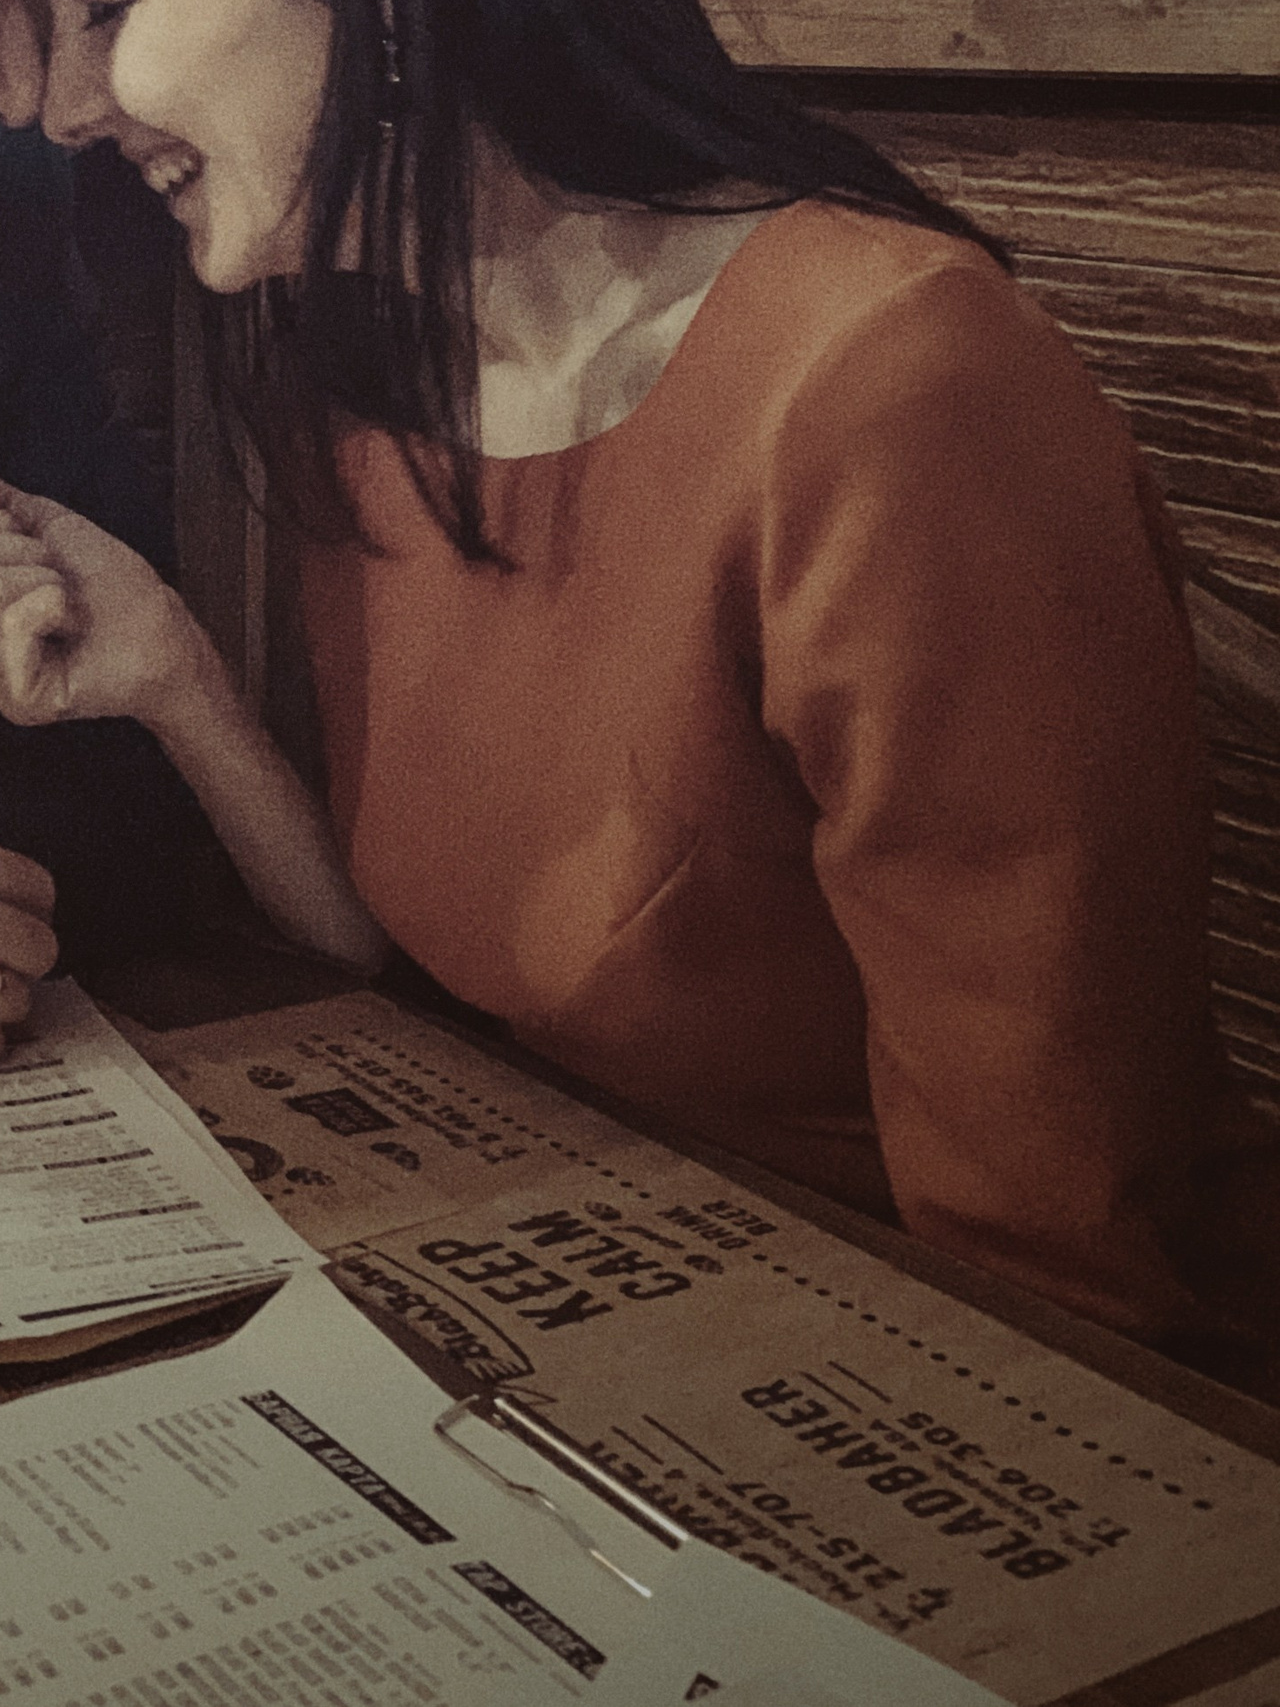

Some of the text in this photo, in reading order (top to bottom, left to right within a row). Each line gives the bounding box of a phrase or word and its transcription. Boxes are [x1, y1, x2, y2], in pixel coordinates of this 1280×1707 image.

[508, 1210, 691, 1300] CALM
[657, 1205, 752, 1251] DRINK
[701, 1200, 778, 1237] BEER
[418, 1238, 614, 1331] KEEP
[318, 1446, 387, 1496] КАРТА
[741, 1377, 1071, 1581] BLADBAHER
[897, 1411, 1084, 1520] 206-305
[726, 1481, 908, 1591] 215-707
